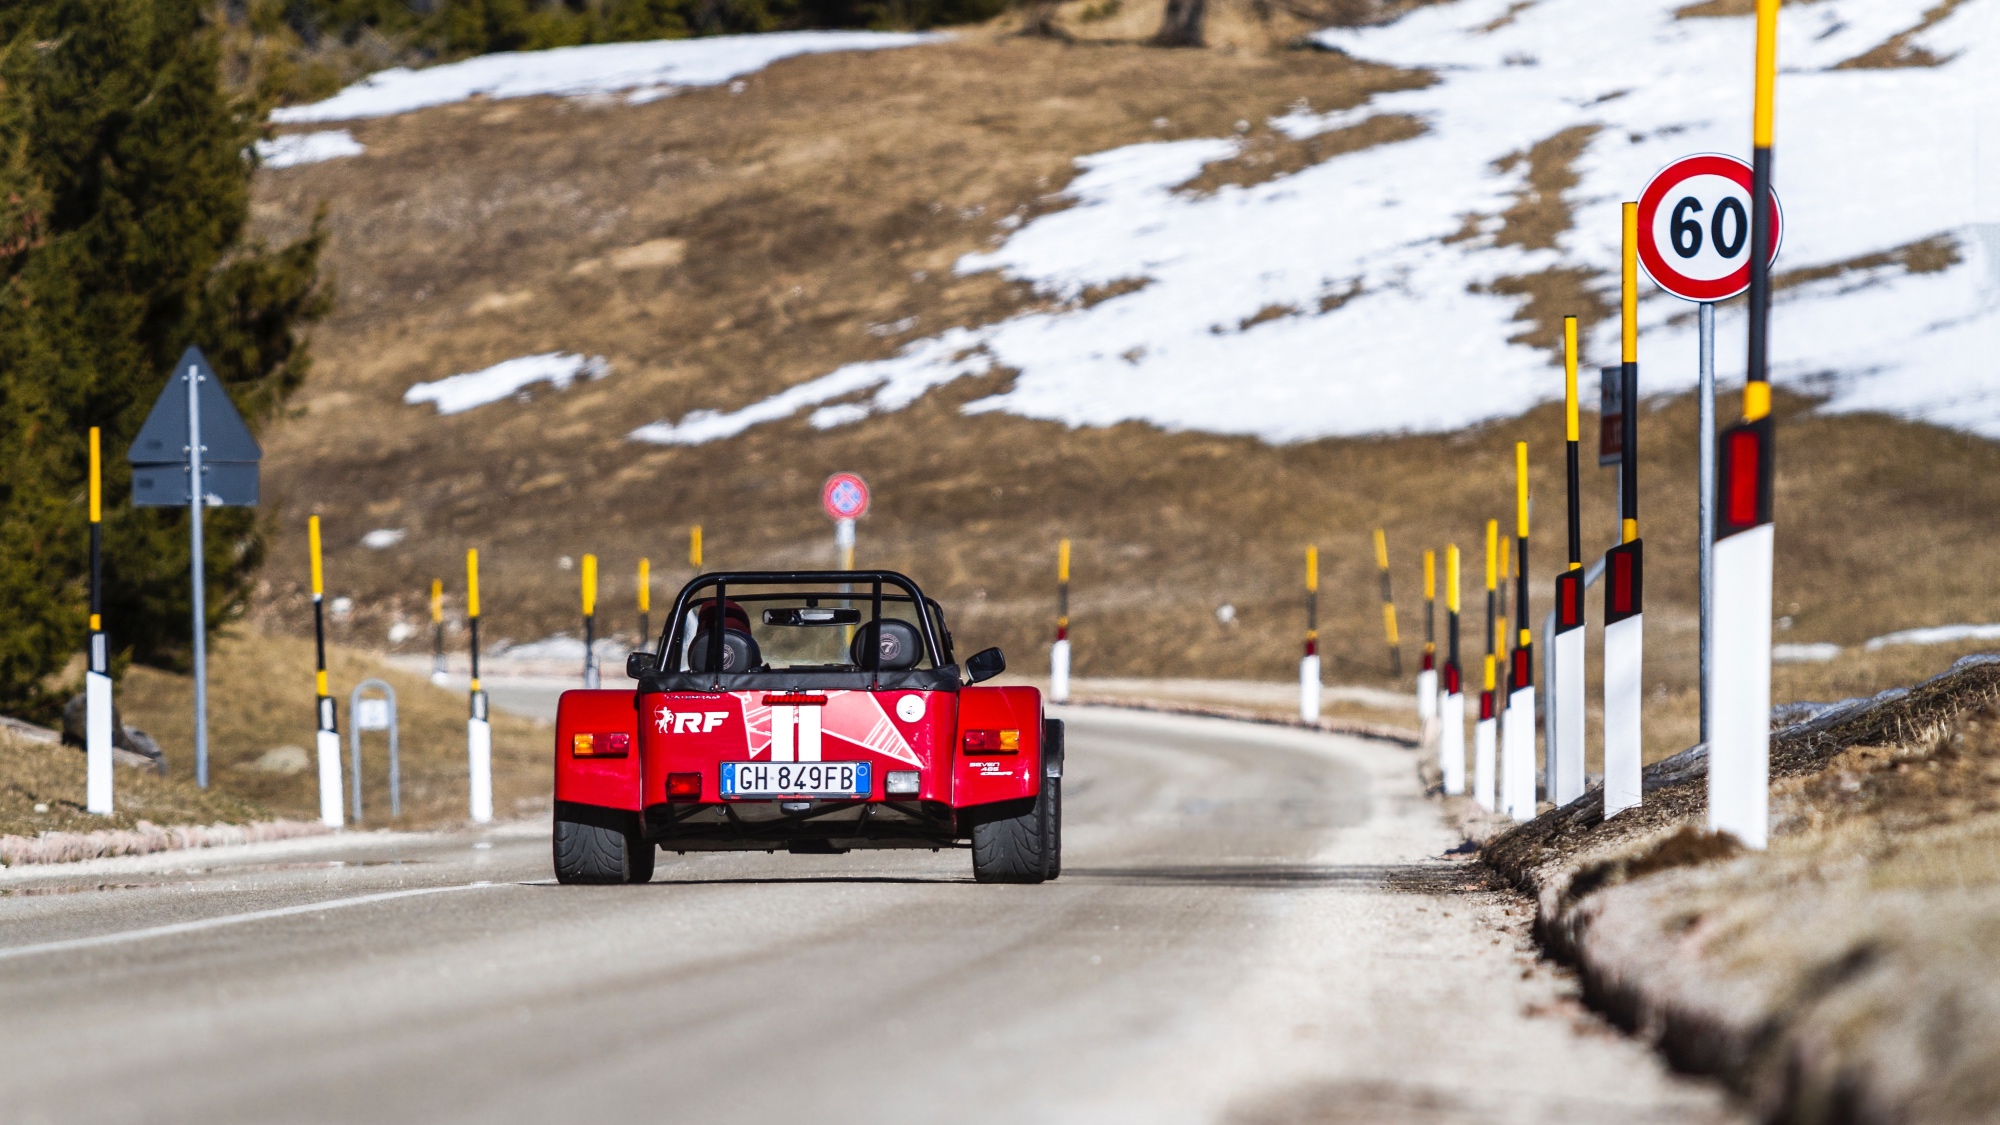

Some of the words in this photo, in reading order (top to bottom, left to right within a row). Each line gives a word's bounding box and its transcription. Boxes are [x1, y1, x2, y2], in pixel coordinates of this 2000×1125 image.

[1670, 196, 1748, 259] 60
[673, 711, 730, 734] RF
[740, 766, 768, 790] GH
[778, 766, 853, 790] 849FB
